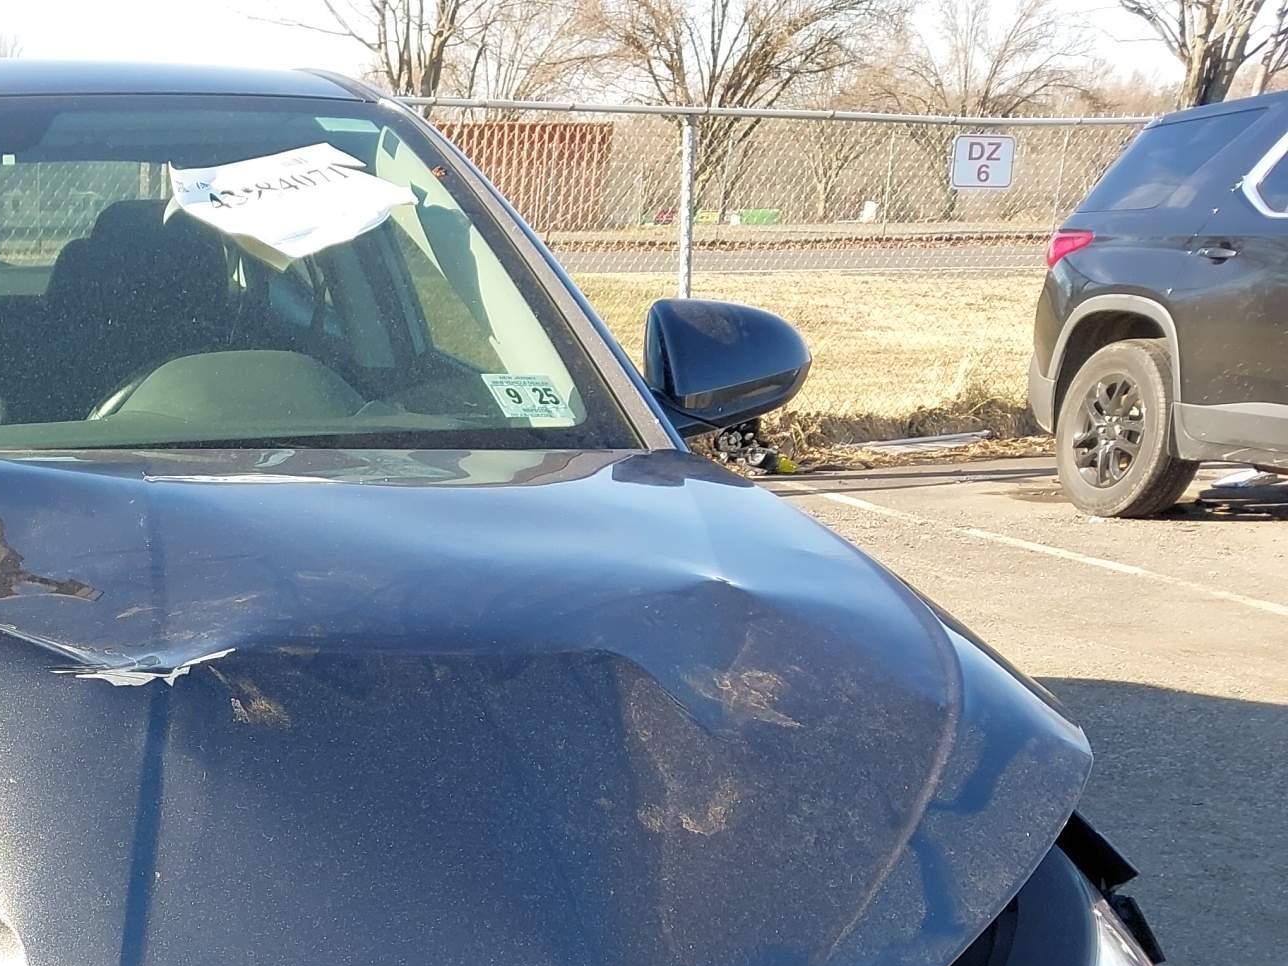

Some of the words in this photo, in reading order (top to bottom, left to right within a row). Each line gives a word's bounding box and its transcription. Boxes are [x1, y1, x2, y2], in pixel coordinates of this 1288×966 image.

[968, 141, 1002, 161] DZ
[977, 164, 990, 182] 6
[505, 387, 523, 405] 9
[531, 387, 561, 405] 25
